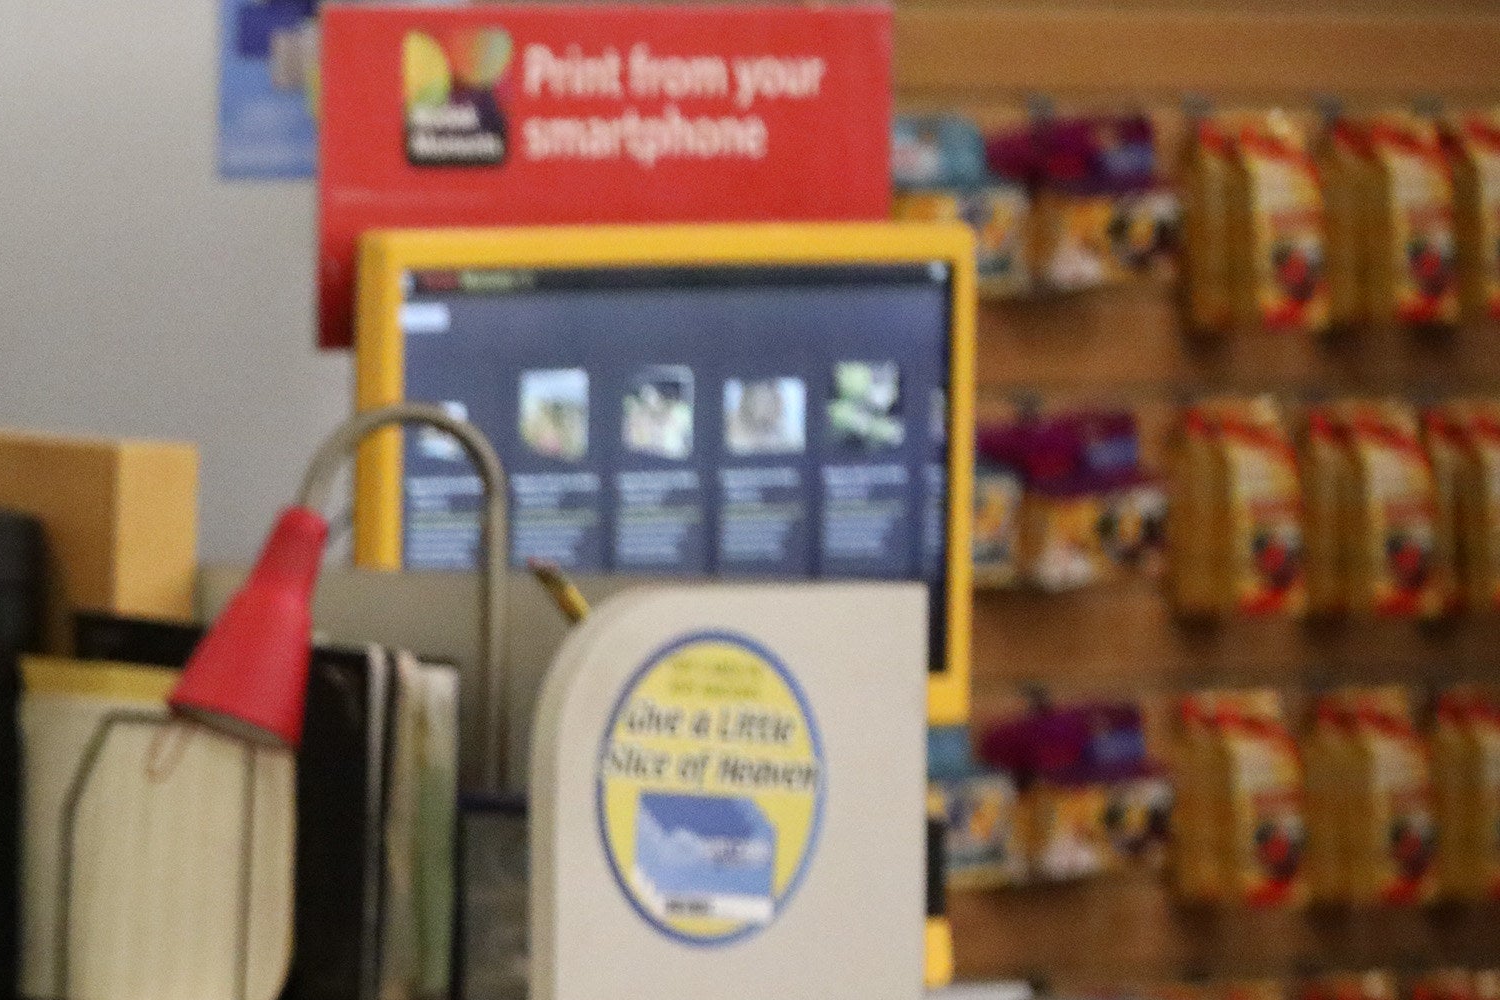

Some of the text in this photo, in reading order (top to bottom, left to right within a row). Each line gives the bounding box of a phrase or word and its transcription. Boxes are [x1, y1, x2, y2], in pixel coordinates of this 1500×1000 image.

[523, 44, 827, 110] Print from your
[523, 104, 768, 168] smartphone
